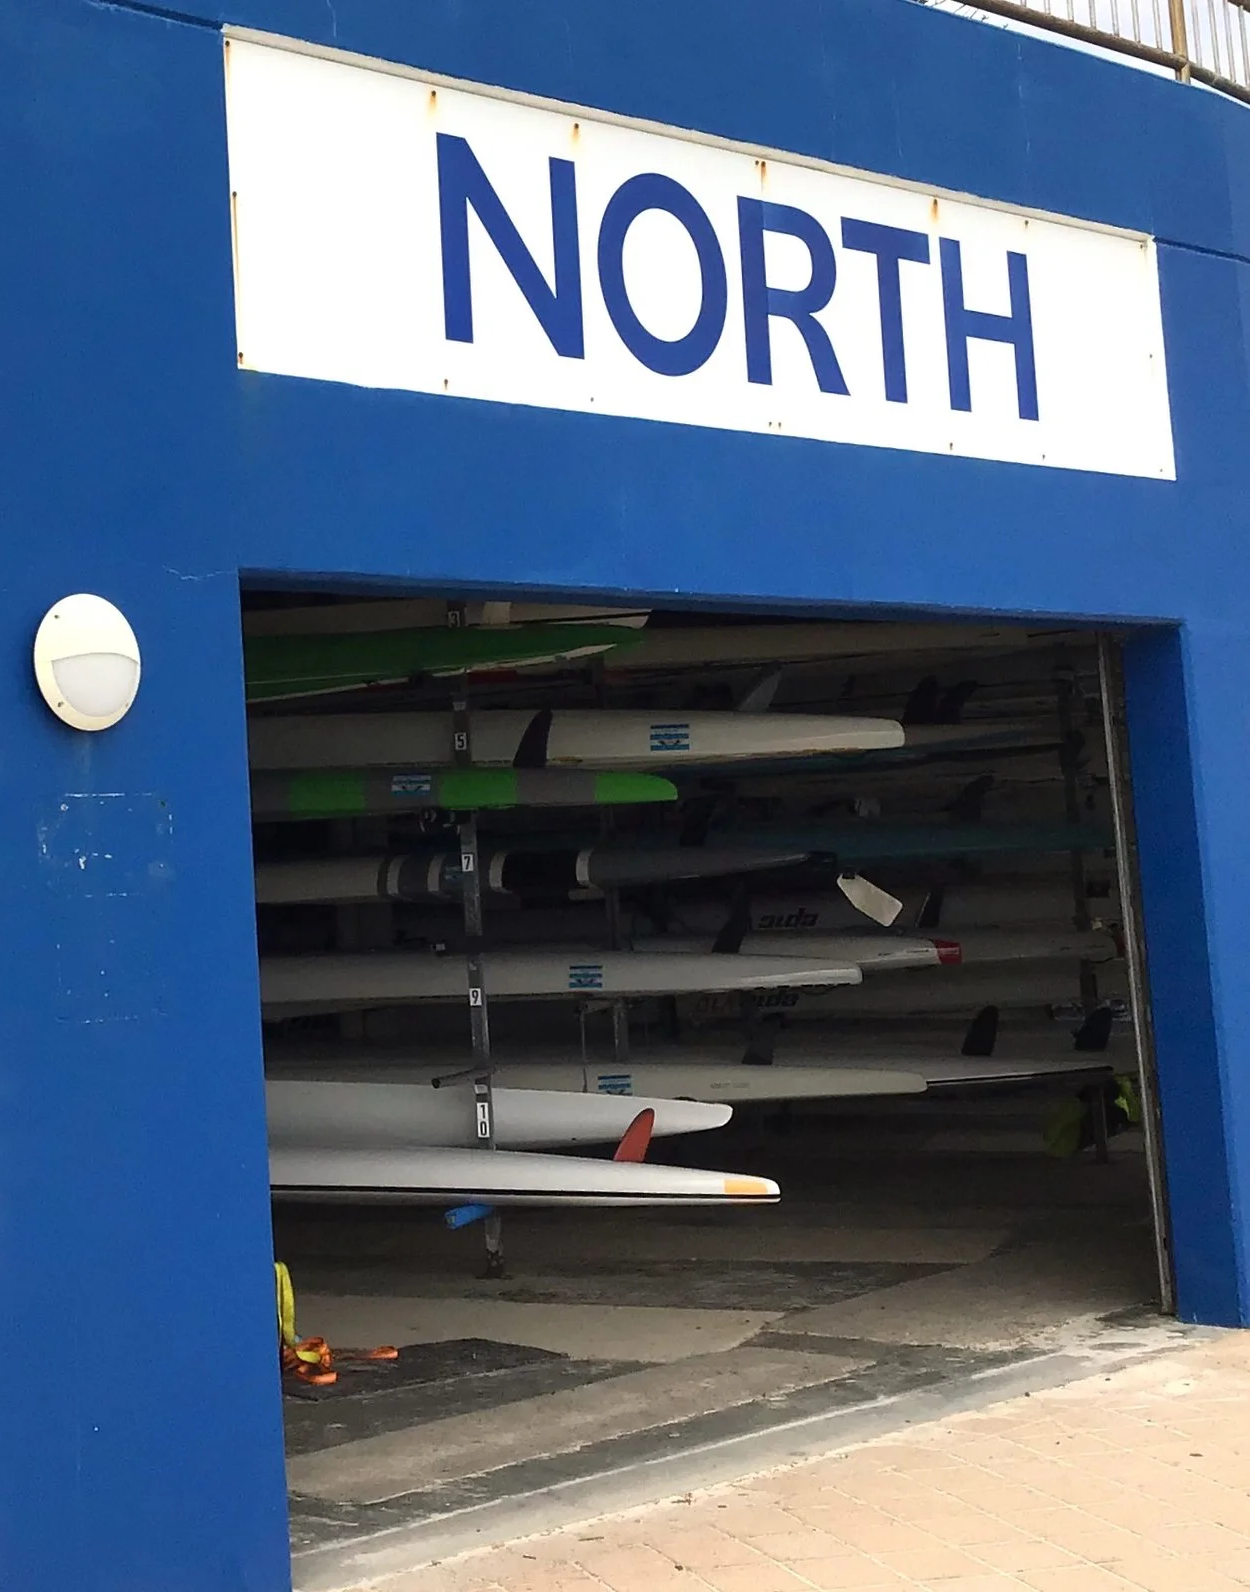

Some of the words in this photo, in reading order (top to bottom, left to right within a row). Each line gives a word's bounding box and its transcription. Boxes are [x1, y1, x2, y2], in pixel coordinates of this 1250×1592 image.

[436, 131, 1040, 422] NORTH
[456, 733, 465, 749] 5
[463, 855, 472, 871] 7
[471, 990, 480, 1005] 9
